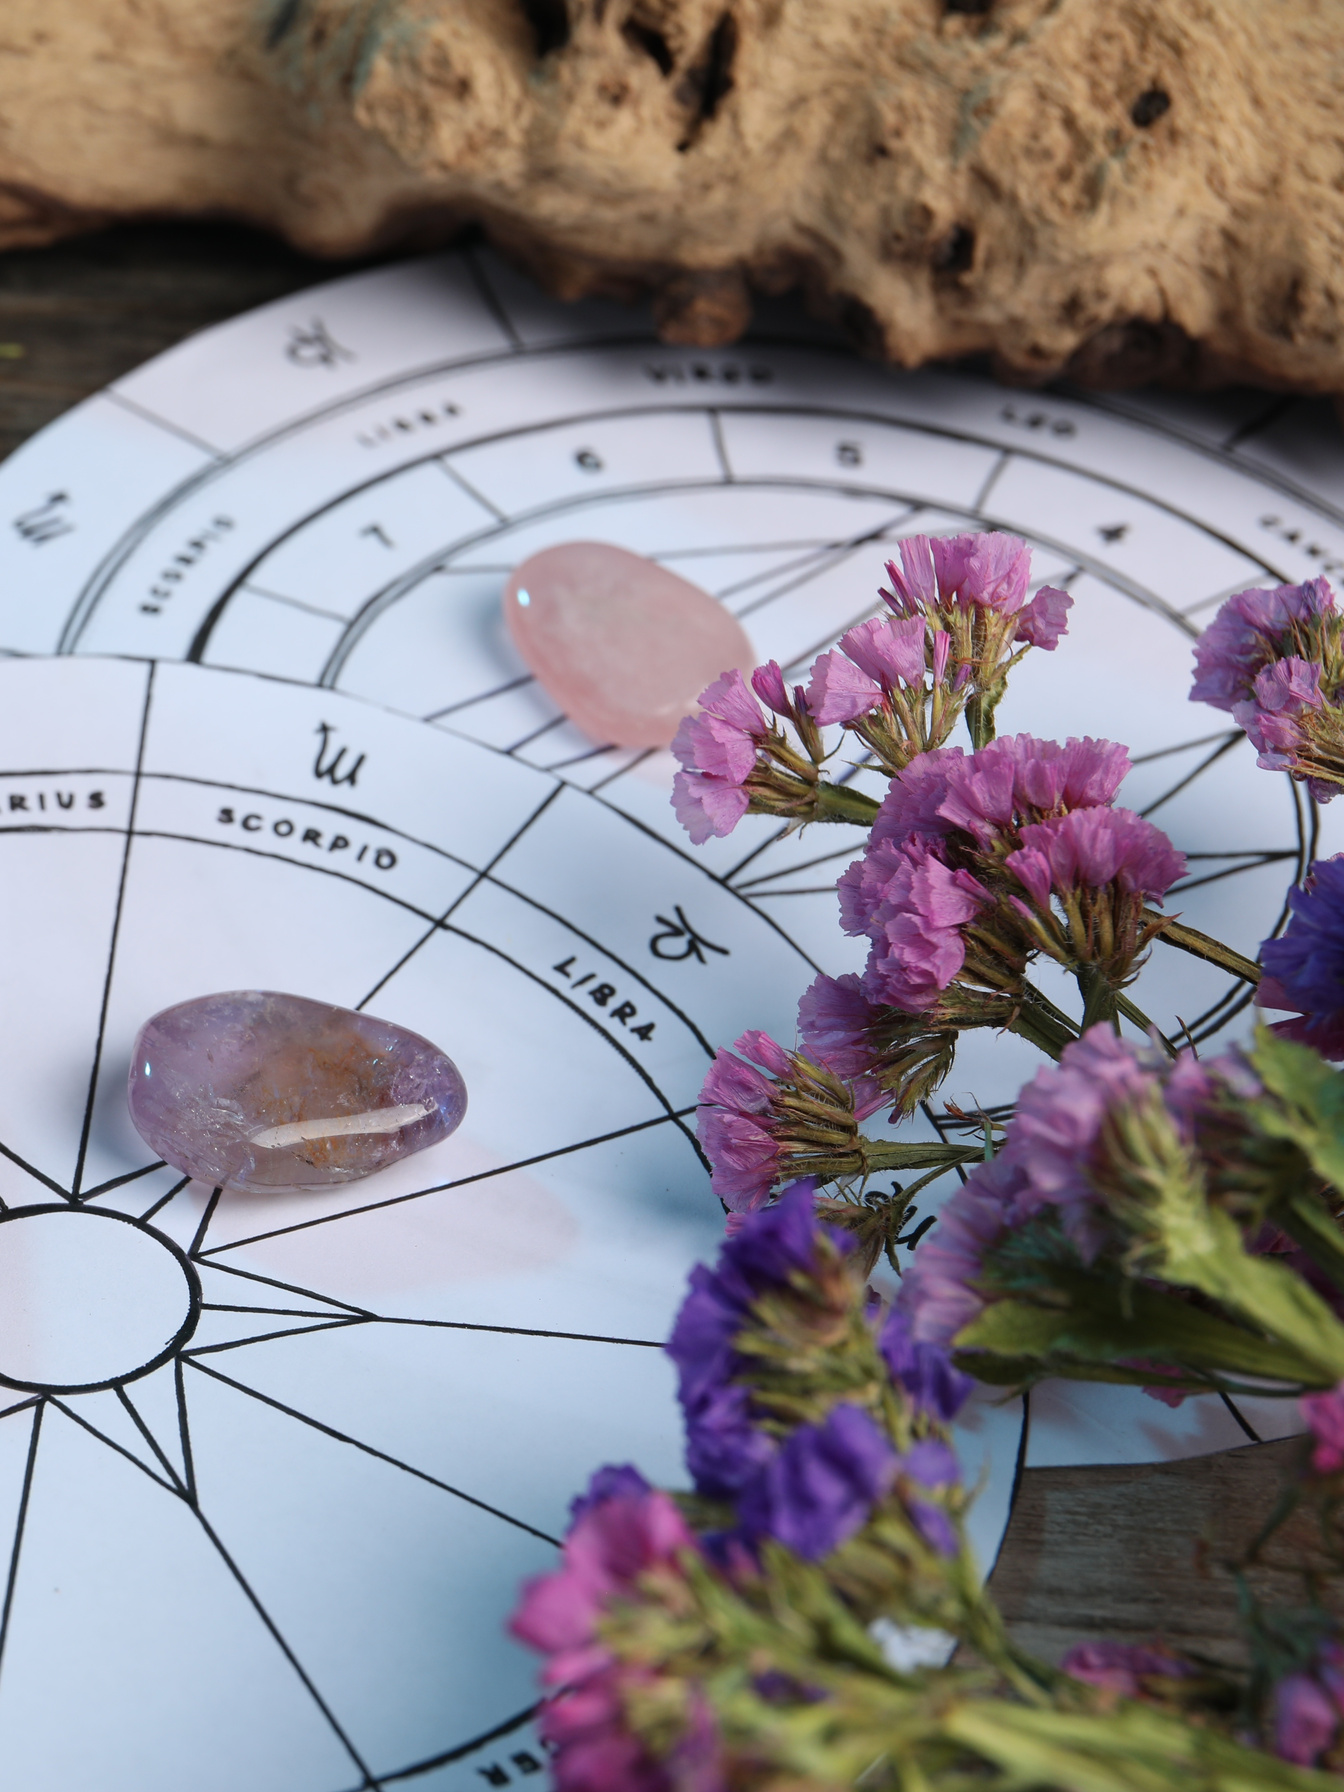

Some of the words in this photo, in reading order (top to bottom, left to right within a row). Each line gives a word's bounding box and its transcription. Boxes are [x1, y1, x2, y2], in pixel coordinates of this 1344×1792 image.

[571, 446, 605, 475] 6
[834, 439, 864, 469] 5
[359, 523, 394, 550] 7
[1096, 522, 1130, 545] 4
[216, 806, 399, 871] SCORPIO
[551, 956, 657, 1043] LIBRA
